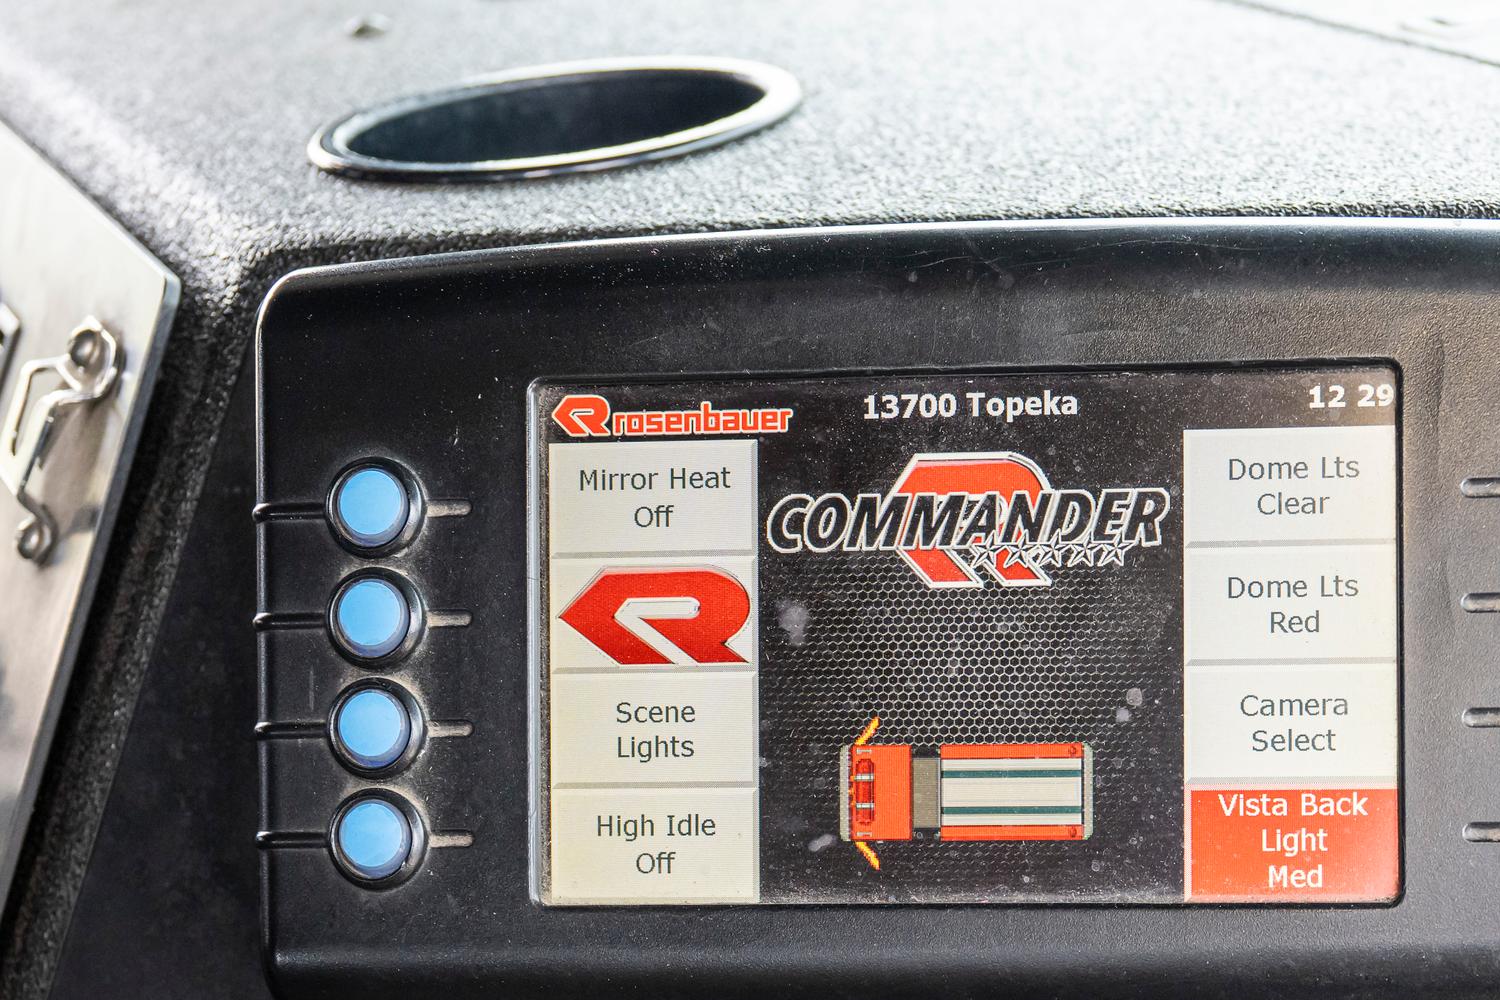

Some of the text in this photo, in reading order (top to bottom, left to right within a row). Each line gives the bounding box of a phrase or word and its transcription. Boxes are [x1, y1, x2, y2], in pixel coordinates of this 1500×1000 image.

[863, 390, 1077, 422] 13700 Topeka
[1309, 384, 1394, 408] 12 29
[579, 467, 731, 491] Mirror Heat
[1229, 457, 1359, 480] Dome Lts
[1257, 493, 1330, 515] Clear
[634, 505, 673, 528] Off
[767, 487, 1171, 553] COMMANDER
[1228, 576, 1358, 599] Dome Lts
[1270, 610, 1320, 633] Red
[616, 702, 695, 723] Scene
[1240, 695, 1348, 717] Camera
[618, 736, 695, 763] Lights
[1252, 730, 1336, 752] Select
[1218, 793, 1368, 815] Vista Back
[597, 814, 716, 842] High Idle
[1261, 829, 1328, 856] Light
[636, 852, 675, 874] Off
[1268, 865, 1323, 888] Med
